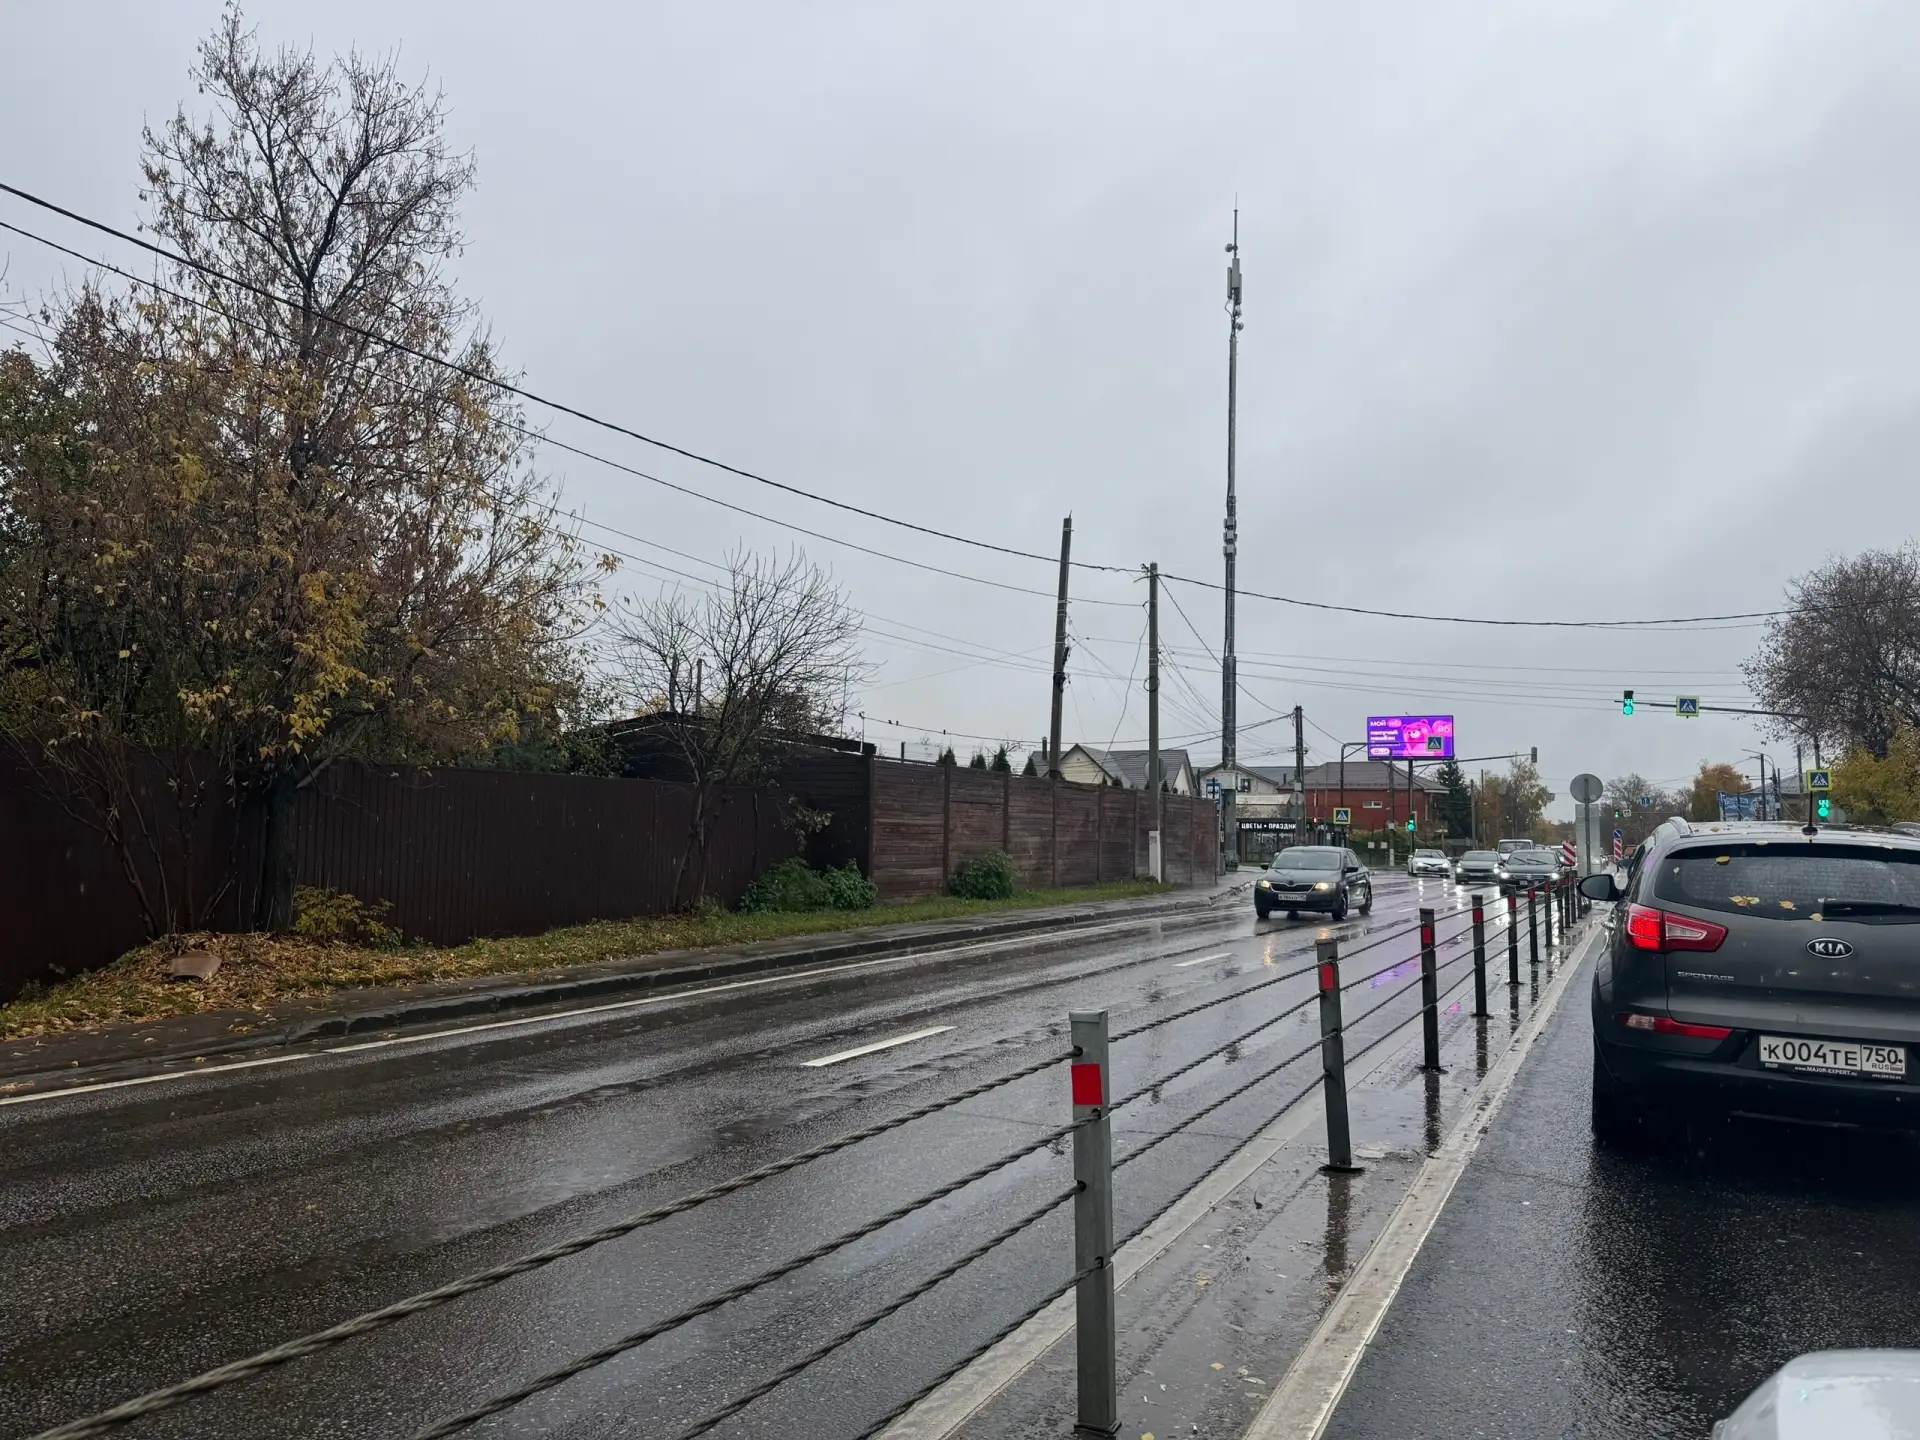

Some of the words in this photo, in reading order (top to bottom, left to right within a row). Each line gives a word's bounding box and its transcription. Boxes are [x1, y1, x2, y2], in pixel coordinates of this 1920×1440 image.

[1241, 822, 1262, 830] ЦВЕТЫ
[1268, 823, 1297, 831] ПРАЗДНИ
[1814, 942, 1846, 954] KIA
[1677, 971, 1735, 982] SPORTAGE
[1767, 1041, 1858, 1067] К004ТЕ
[1862, 1046, 1898, 1064] 750
[1871, 1063, 1890, 1071] RUS
